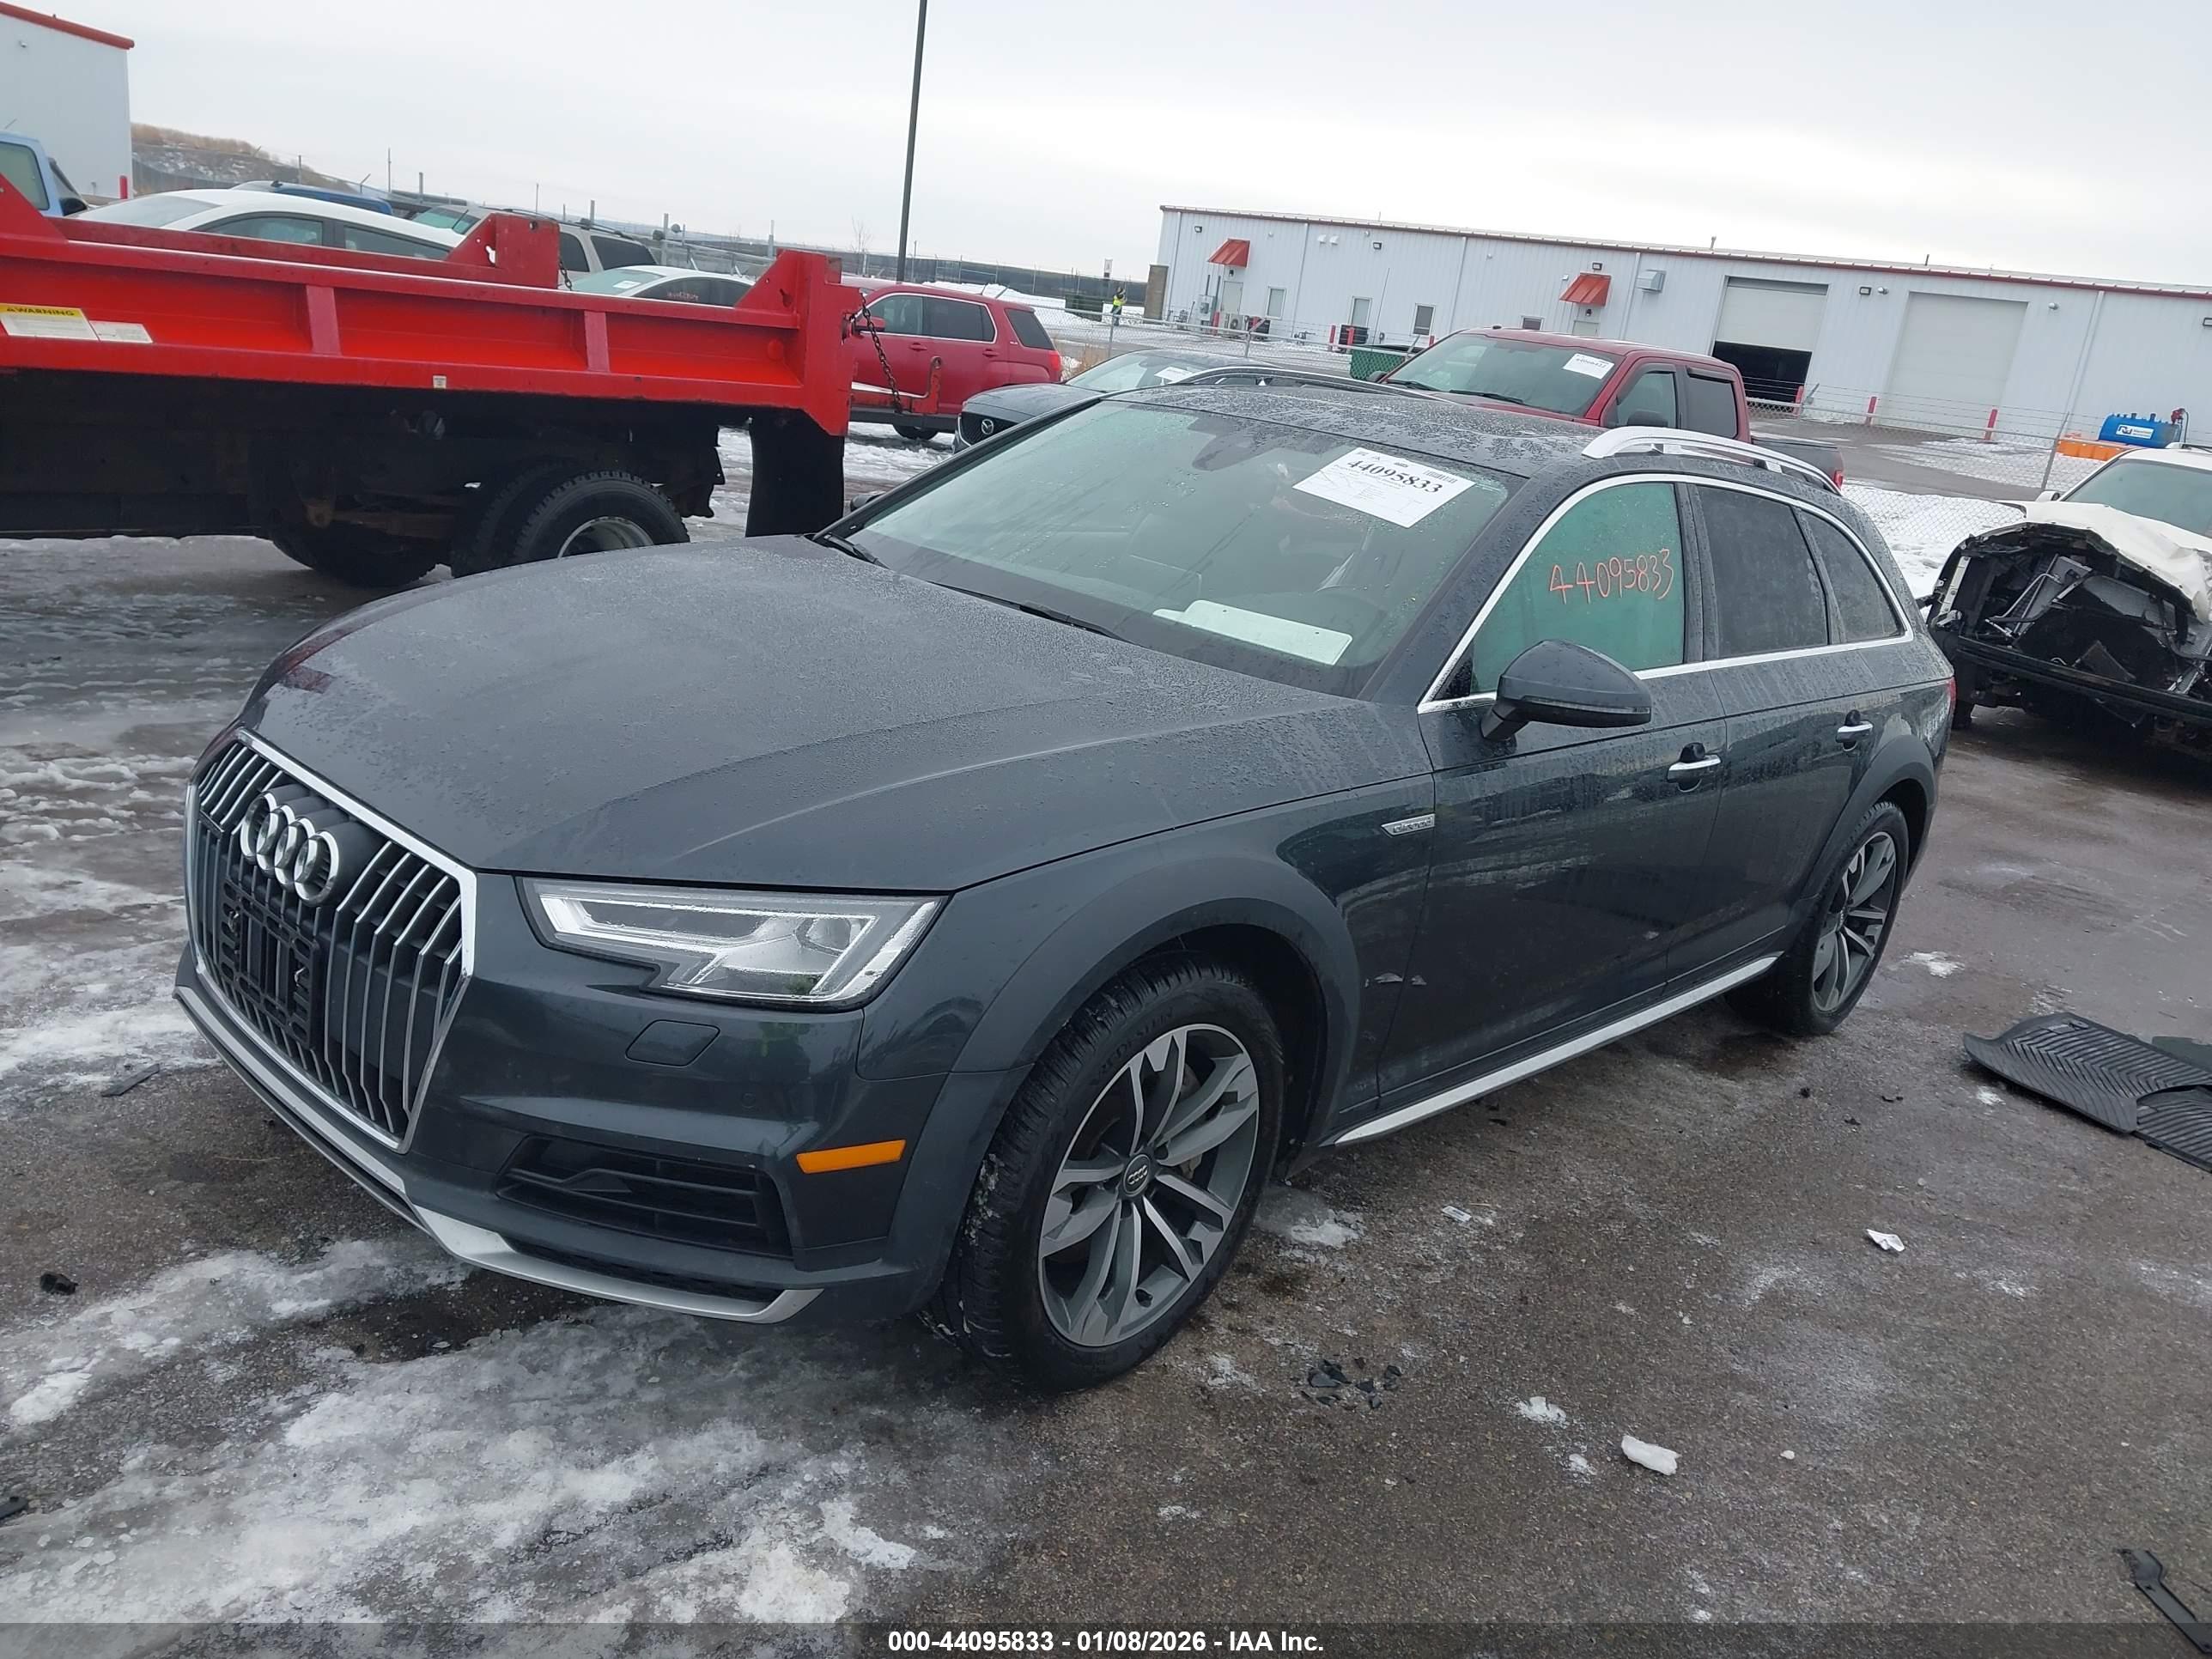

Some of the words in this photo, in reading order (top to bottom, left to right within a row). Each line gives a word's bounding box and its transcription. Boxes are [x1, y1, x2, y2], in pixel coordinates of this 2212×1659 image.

[16, 307, 75, 316] WARNING
[1346, 459, 1443, 494] 44095833
[1549, 548, 1674, 605] 44095833
